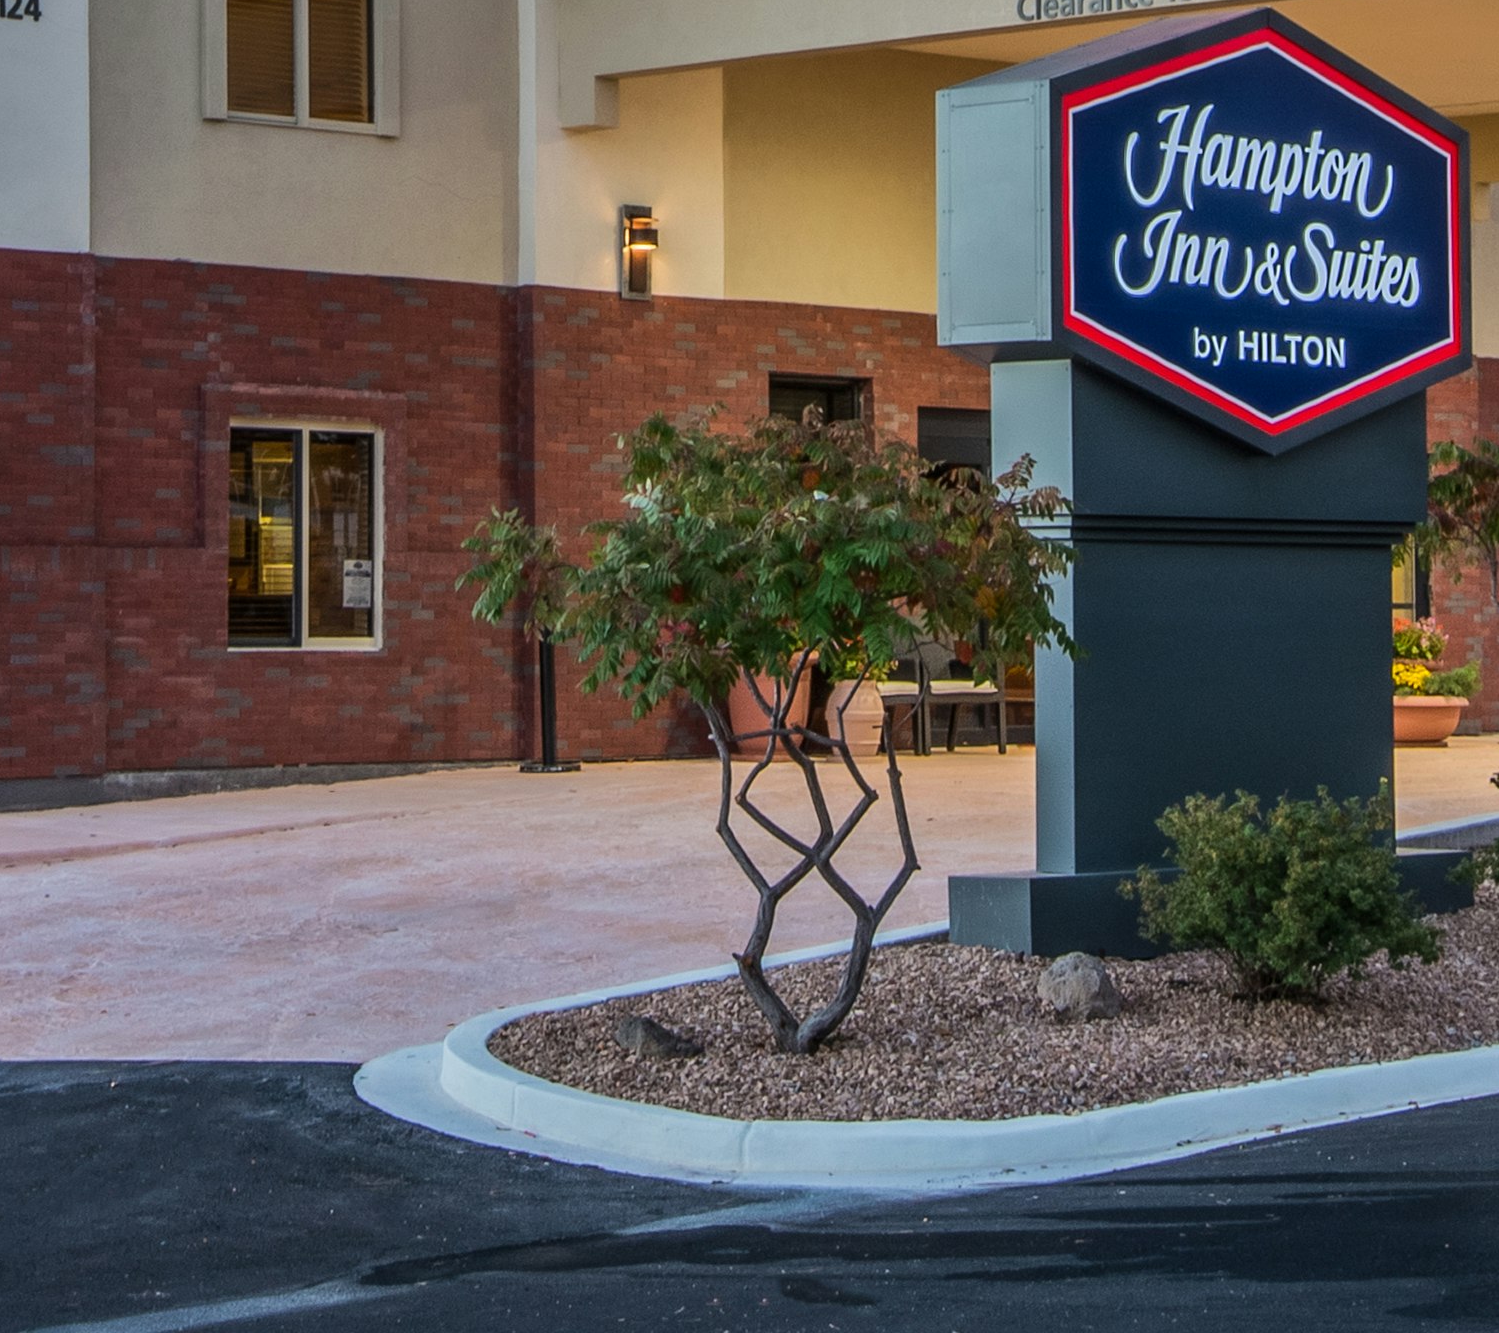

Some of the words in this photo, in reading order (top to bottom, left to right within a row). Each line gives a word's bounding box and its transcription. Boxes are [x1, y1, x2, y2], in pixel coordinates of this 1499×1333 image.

[1123, 103, 1394, 218] Hampton
[1113, 209, 1253, 299] Inn
[1254, 242, 1290, 306] &
[1284, 221, 1421, 308] Suites
[1193, 327, 1228, 366] by
[1237, 329, 1347, 368] HILTON
